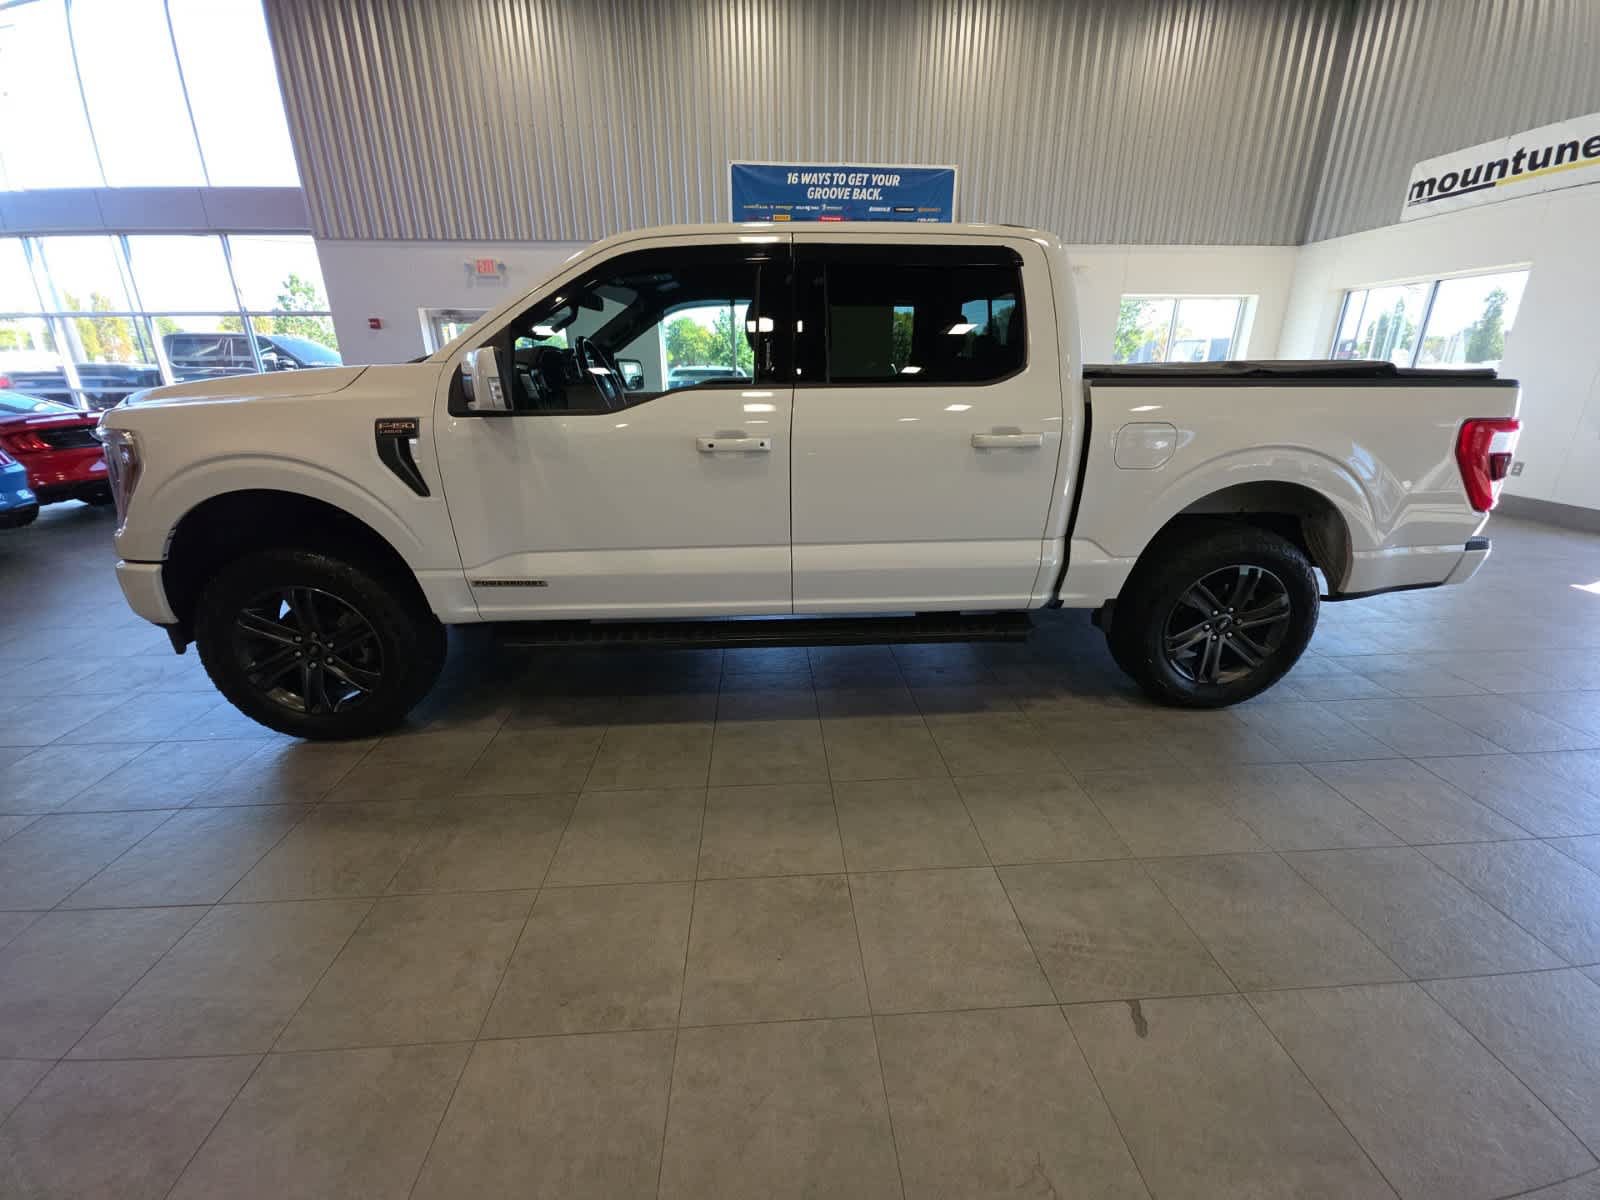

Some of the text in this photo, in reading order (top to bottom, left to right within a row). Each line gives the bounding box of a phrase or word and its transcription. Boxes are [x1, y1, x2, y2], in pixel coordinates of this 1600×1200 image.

[1408, 135, 1600, 201] mountune
[787, 172, 901, 187] 16 WAYS TO GET YOUR
[807, 187, 883, 201] GROOVE BACK.
